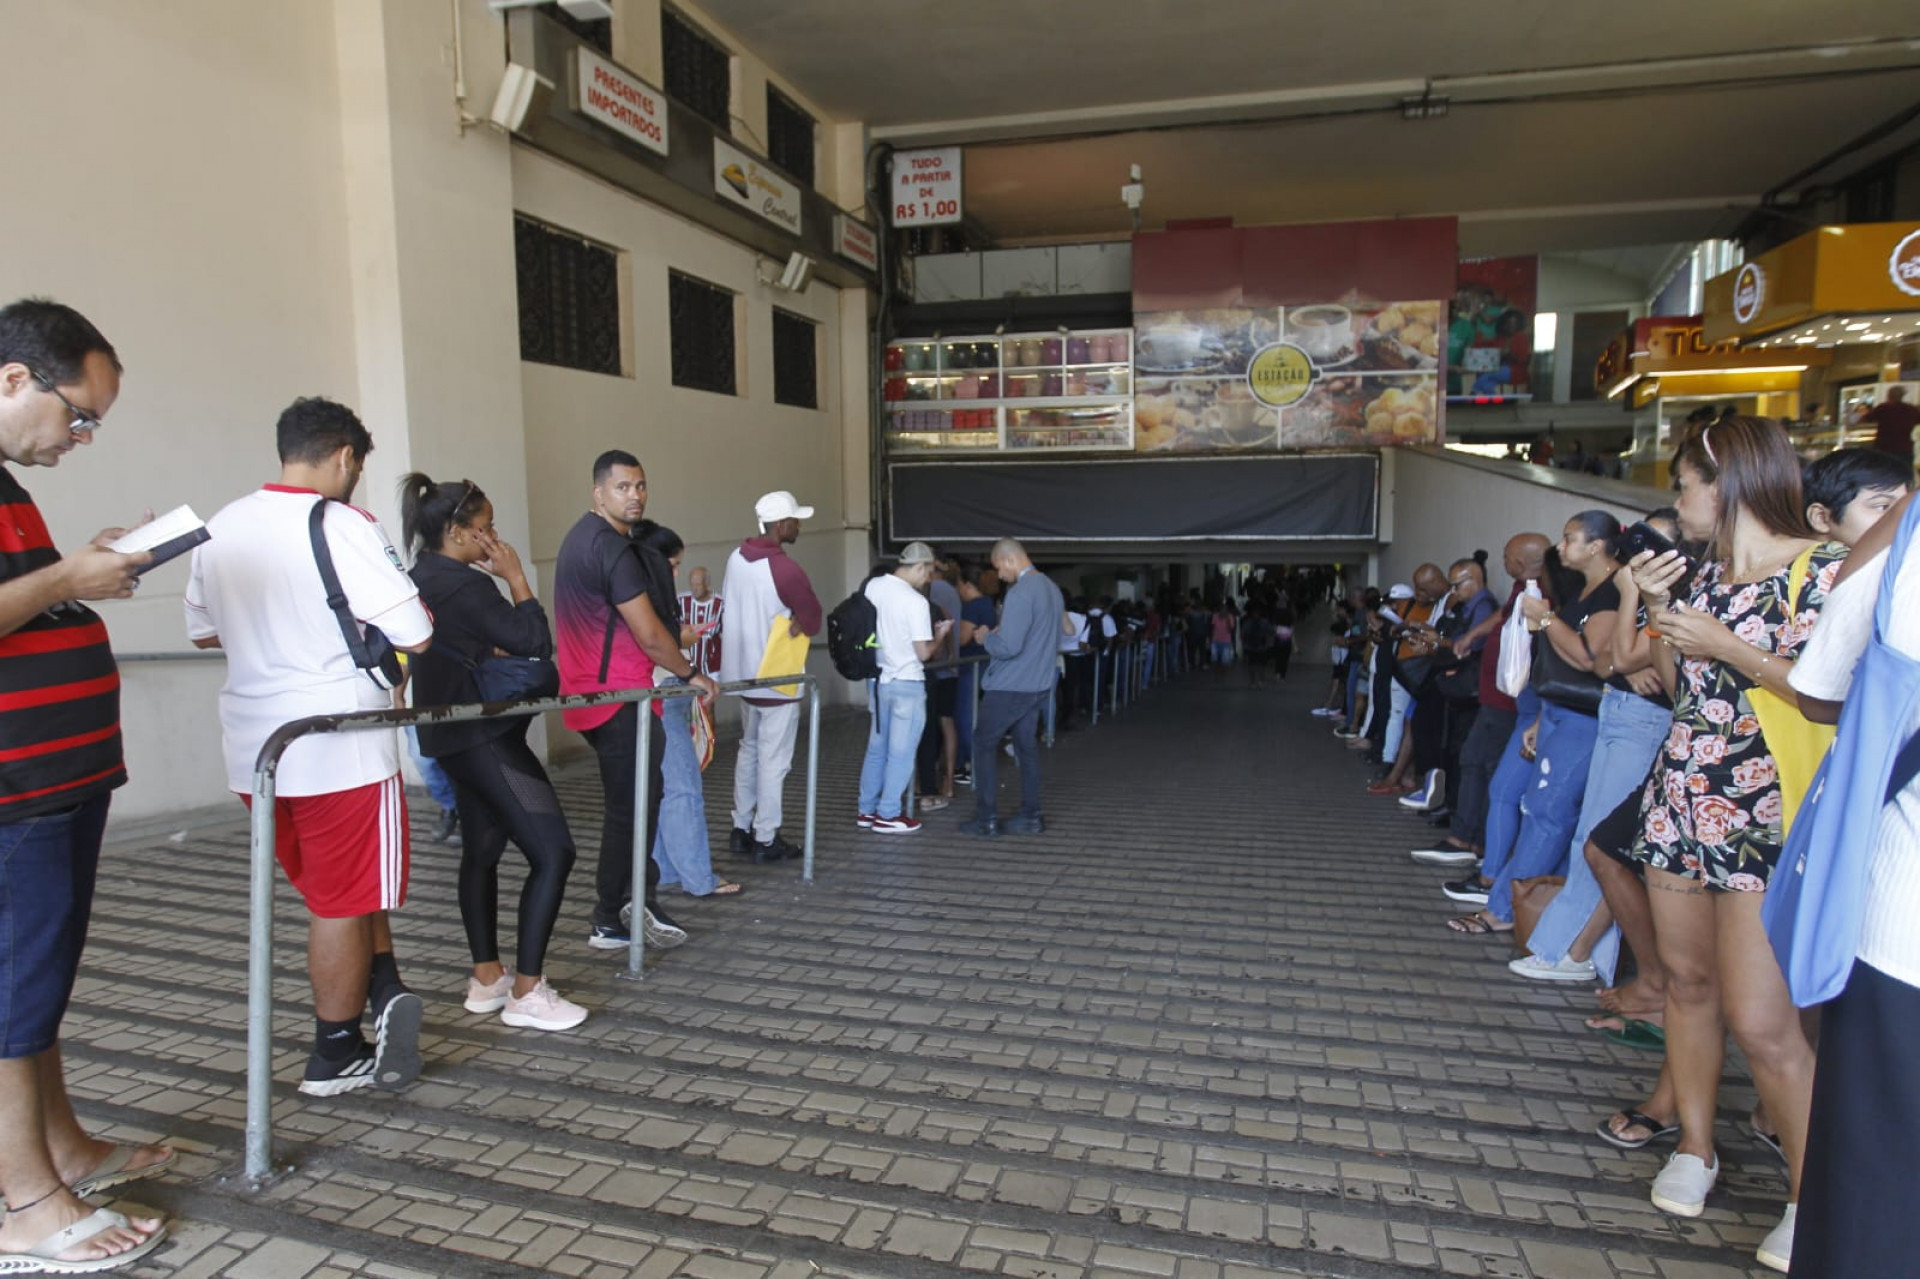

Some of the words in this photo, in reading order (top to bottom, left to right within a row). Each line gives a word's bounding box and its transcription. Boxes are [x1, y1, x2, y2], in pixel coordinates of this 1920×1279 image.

[594, 66, 655, 116] PRESENTES
[587, 86, 662, 142] IMPORTADOS
[911, 157, 942, 169] TUDO
[902, 174, 909, 185] A
[912, 170, 951, 184] PARTIR
[919, 188, 934, 198] DE
[896, 203, 916, 219] R$
[922, 200, 957, 219] 1,00
